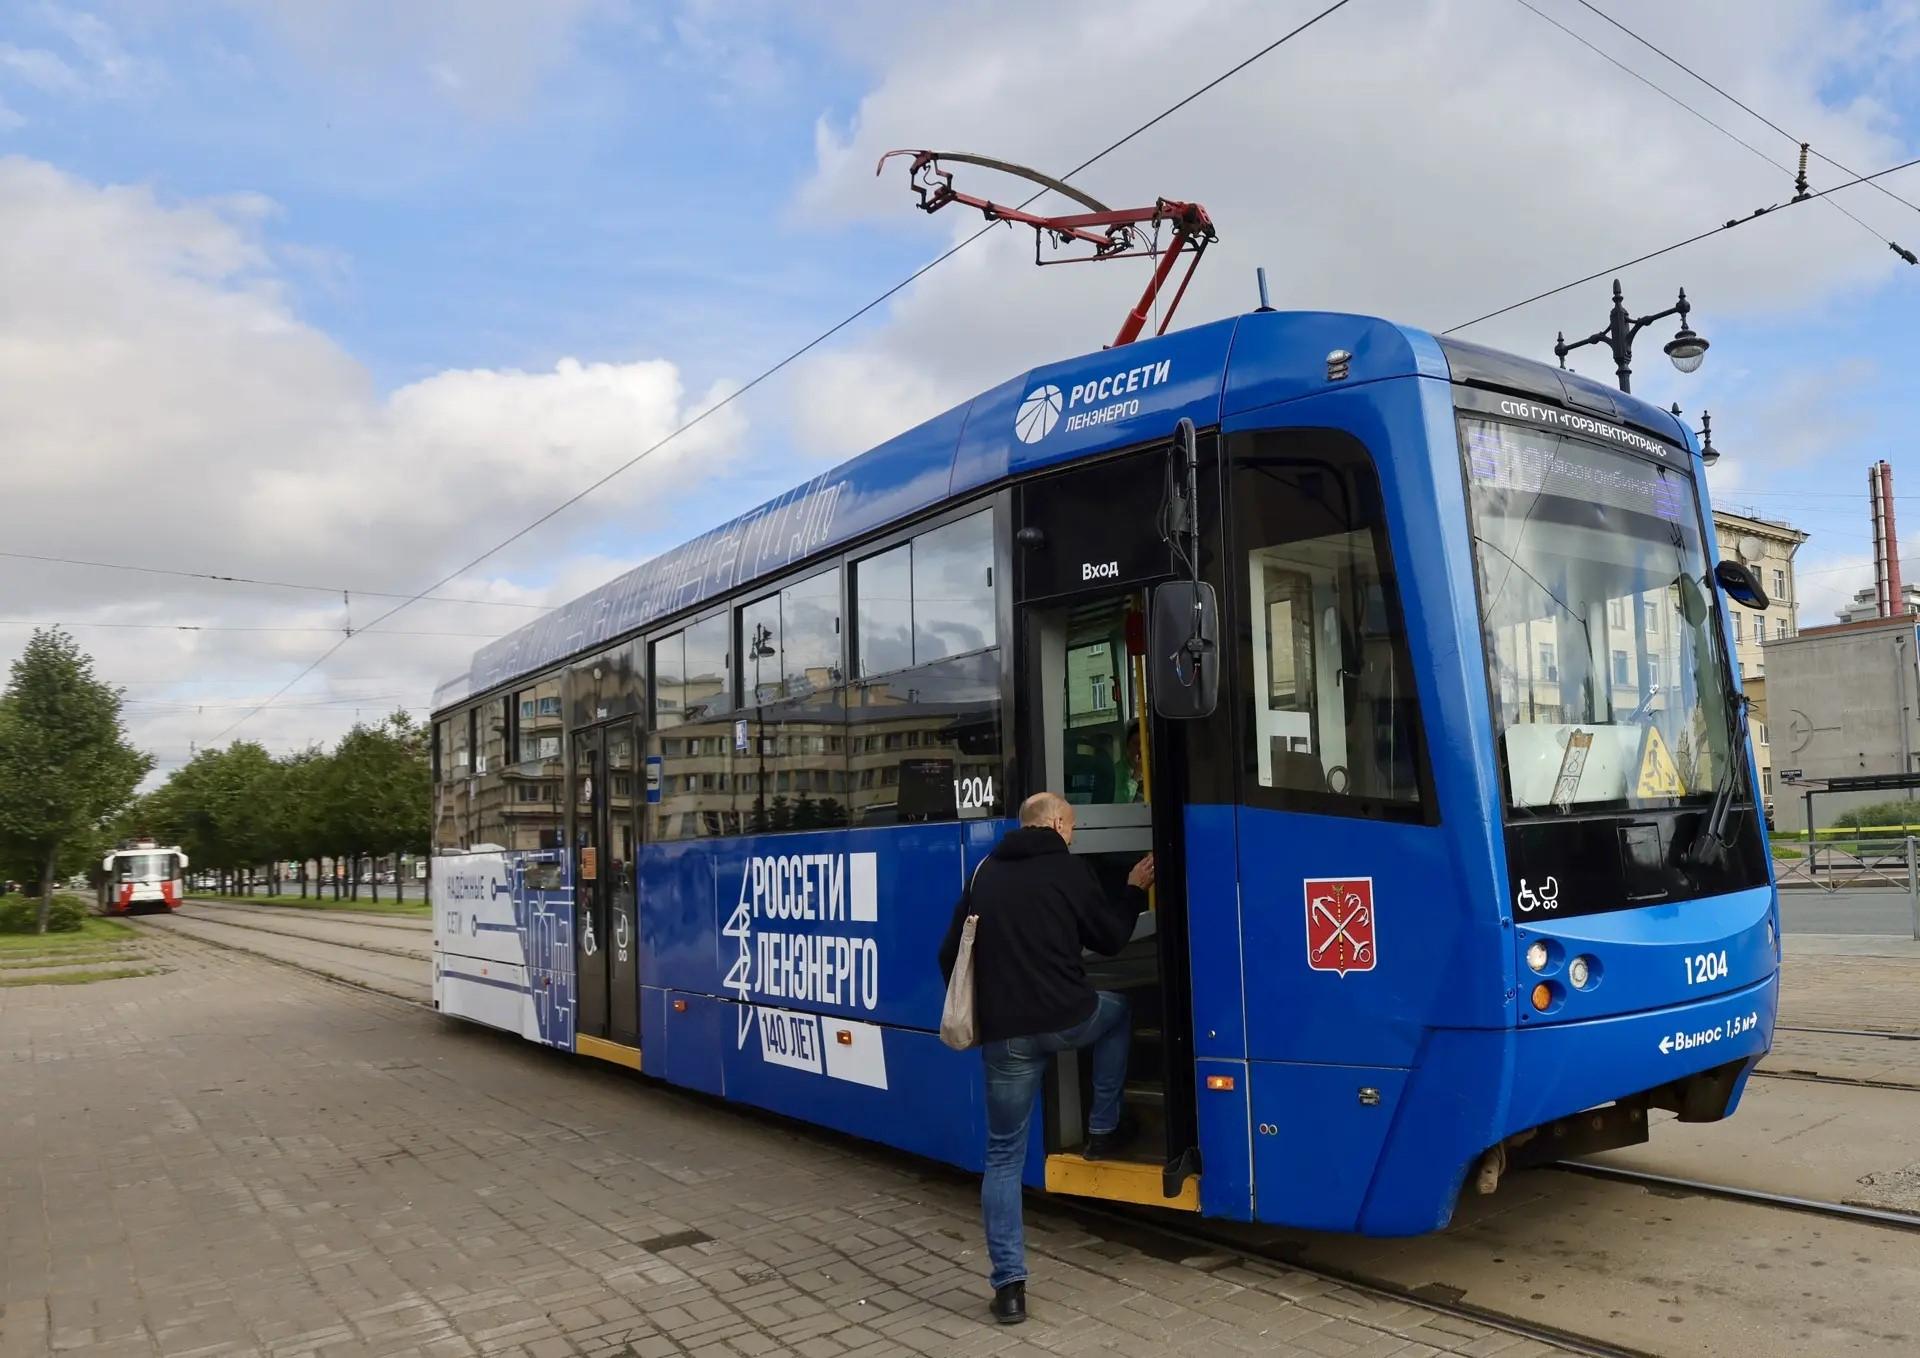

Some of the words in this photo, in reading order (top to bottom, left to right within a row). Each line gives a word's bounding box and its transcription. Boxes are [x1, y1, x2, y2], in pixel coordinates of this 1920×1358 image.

[1069, 359, 1171, 408] РОССЕТИ
[1065, 399, 1139, 433] ЛЕНЭНЕРГО
[1501, 400, 1529, 417] СПб
[1531, 406, 1558, 423] ГУП
[1560, 414, 1667, 457] «ГОРЭЛЕКТРОТРАНС»
[1082, 561, 1119, 580] Вход
[953, 775, 995, 809] 1204
[752, 853, 844, 921] РОССЕТИ
[755, 932, 878, 1011] ЛЕНЭНЕРГО
[1684, 950, 1729, 985] 1204
[762, 1014, 787, 1055] 140
[791, 1016, 816, 1062] ЛЕТ
[1675, 1026, 1722, 1051] Вынос
[1725, 1016, 1741, 1039] 1,5
